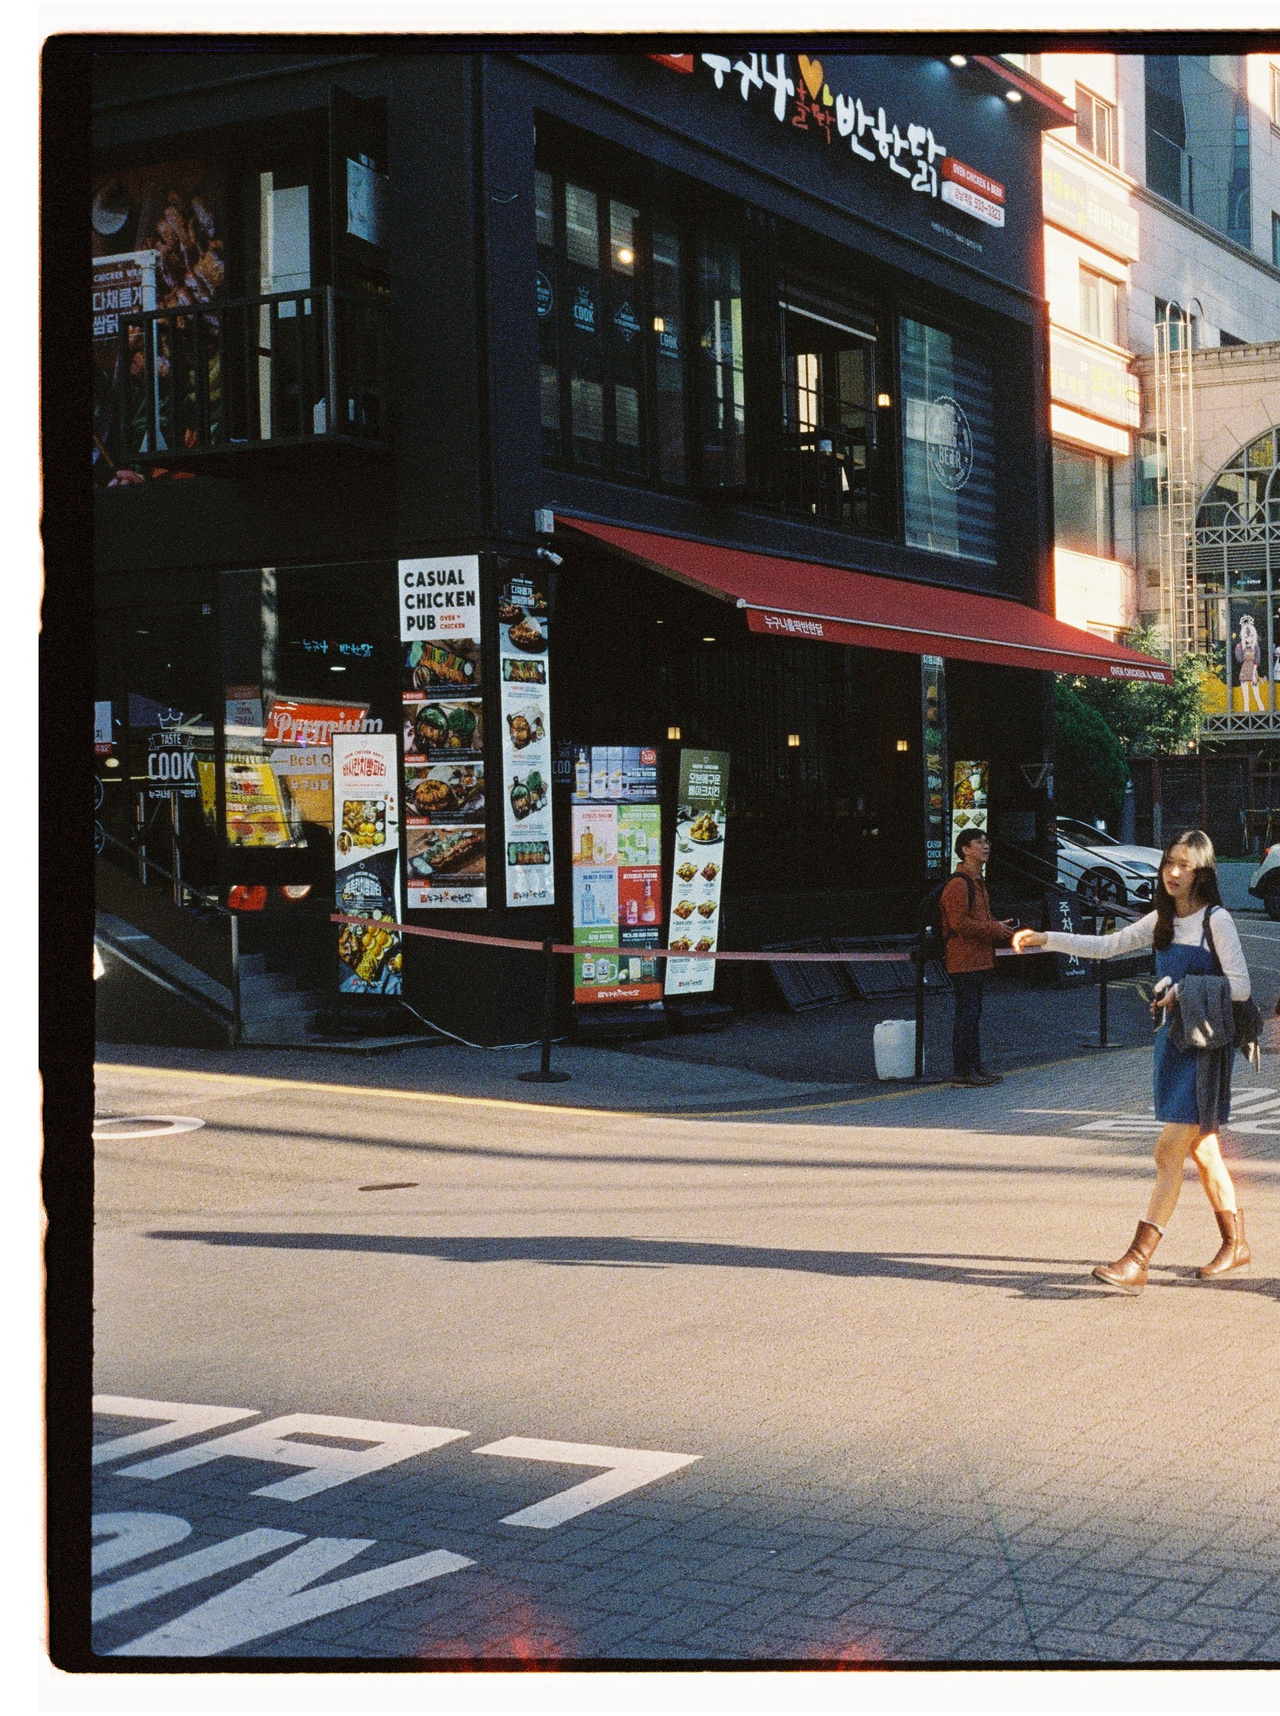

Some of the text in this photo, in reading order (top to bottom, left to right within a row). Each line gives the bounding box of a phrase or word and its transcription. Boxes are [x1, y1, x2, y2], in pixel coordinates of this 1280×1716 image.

[404, 568, 465, 589] CASUAL
[404, 590, 476, 610] CHICKEN
[406, 613, 437, 632] PUB
[273, 711, 384, 743] Premium
[161, 733, 182, 746] TASTE
[148, 752, 196, 781] COOK
[289, 753, 318, 767] Best
